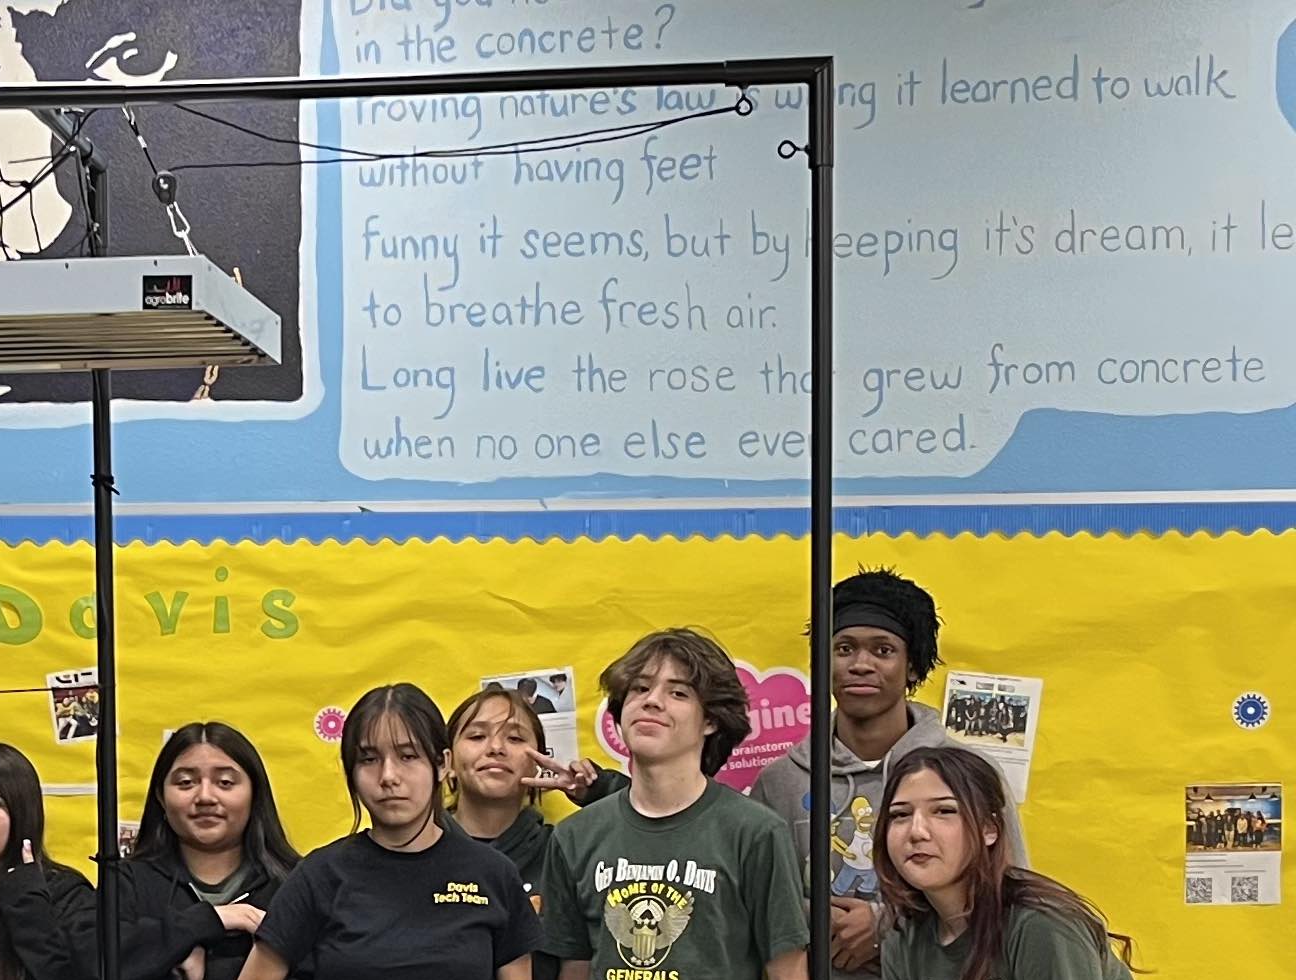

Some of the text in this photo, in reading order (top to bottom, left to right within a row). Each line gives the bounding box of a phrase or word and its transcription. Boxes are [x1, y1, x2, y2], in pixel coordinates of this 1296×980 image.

[355, 29, 382, 64] in
[397, 24, 454, 63] the
[475, 3, 675, 58] concrete?
[500, 87, 637, 120] nature's
[657, 86, 717, 111] law
[897, 70, 921, 106] it
[941, 54, 1079, 105] learned
[1092, 65, 1129, 104] to
[1144, 54, 1237, 99] walk
[359, 135, 718, 204] without having feet
[362, 214, 461, 291] funny
[479, 213, 503, 259] it
[519, 228, 650, 262] seems,
[665, 213, 732, 258] but
[751, 209, 790, 282] by
[985, 209, 1035, 256] it's
[1055, 209, 1193, 257] dream,
[1212, 212, 1238, 252] it
[145, 291, 190, 307] agrobrite
[362, 272, 777, 334] to breathe fresh air.
[361, 344, 456, 419] Long
[482, 347, 546, 394] live
[572, 352, 628, 394] the
[648, 364, 736, 394] rose
[862, 366, 963, 417] grew
[987, 343, 1076, 394] from
[1097, 345, 1266, 383] concrete
[363, 416, 455, 459] when
[475, 431, 518, 459] no
[534, 430, 602, 459] one
[623, 418, 706, 459] else
[848, 413, 977, 456] cared.
[433, 892, 489, 905] Tech Team
[447, 882, 479, 893] Davis
